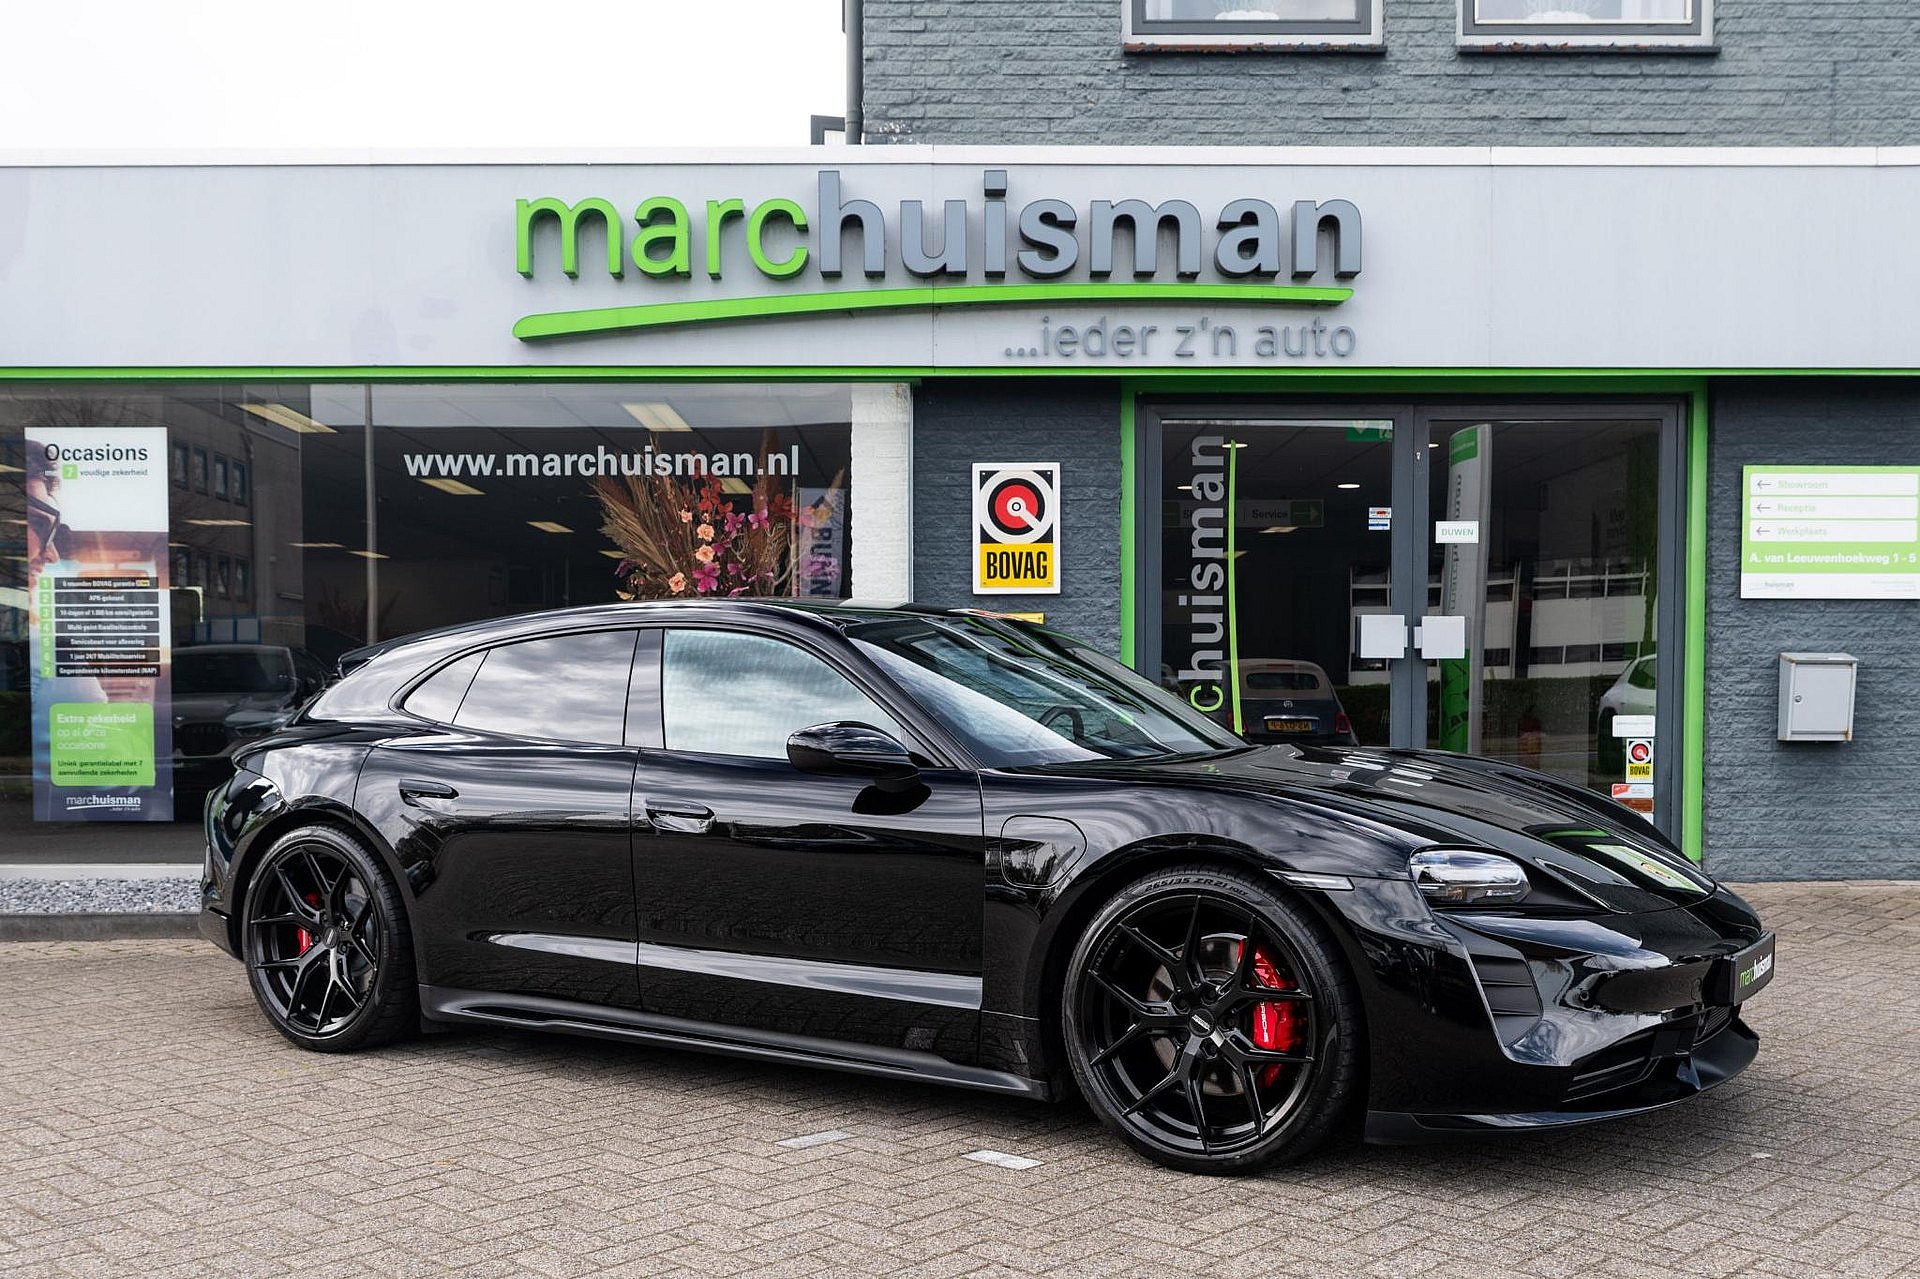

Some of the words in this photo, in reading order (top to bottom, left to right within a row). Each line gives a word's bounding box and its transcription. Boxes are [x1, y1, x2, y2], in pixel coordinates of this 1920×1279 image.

[515, 170, 1362, 280] marchuisman
[1004, 314, 1158, 357] ...ieder
[1175, 316, 1238, 357] z'n
[1254, 314, 1356, 357] auto
[45, 443, 149, 461] Occasions
[403, 445, 799, 477] www.marchuisman.nl
[66, 465, 74, 477] 7
[1252, 508, 1288, 520] Service
[1440, 527, 1475, 537] DUWEN
[986, 550, 1048, 580] BOVAG
[1749, 552, 1761, 564] A.
[1764, 554, 1784, 564] van
[1787, 552, 1890, 566] Leeuwenhoekweg
[56, 713, 84, 724] Extra
[1629, 765, 1650, 776] BOVAG
[65, 794, 142, 805] marchuisman
